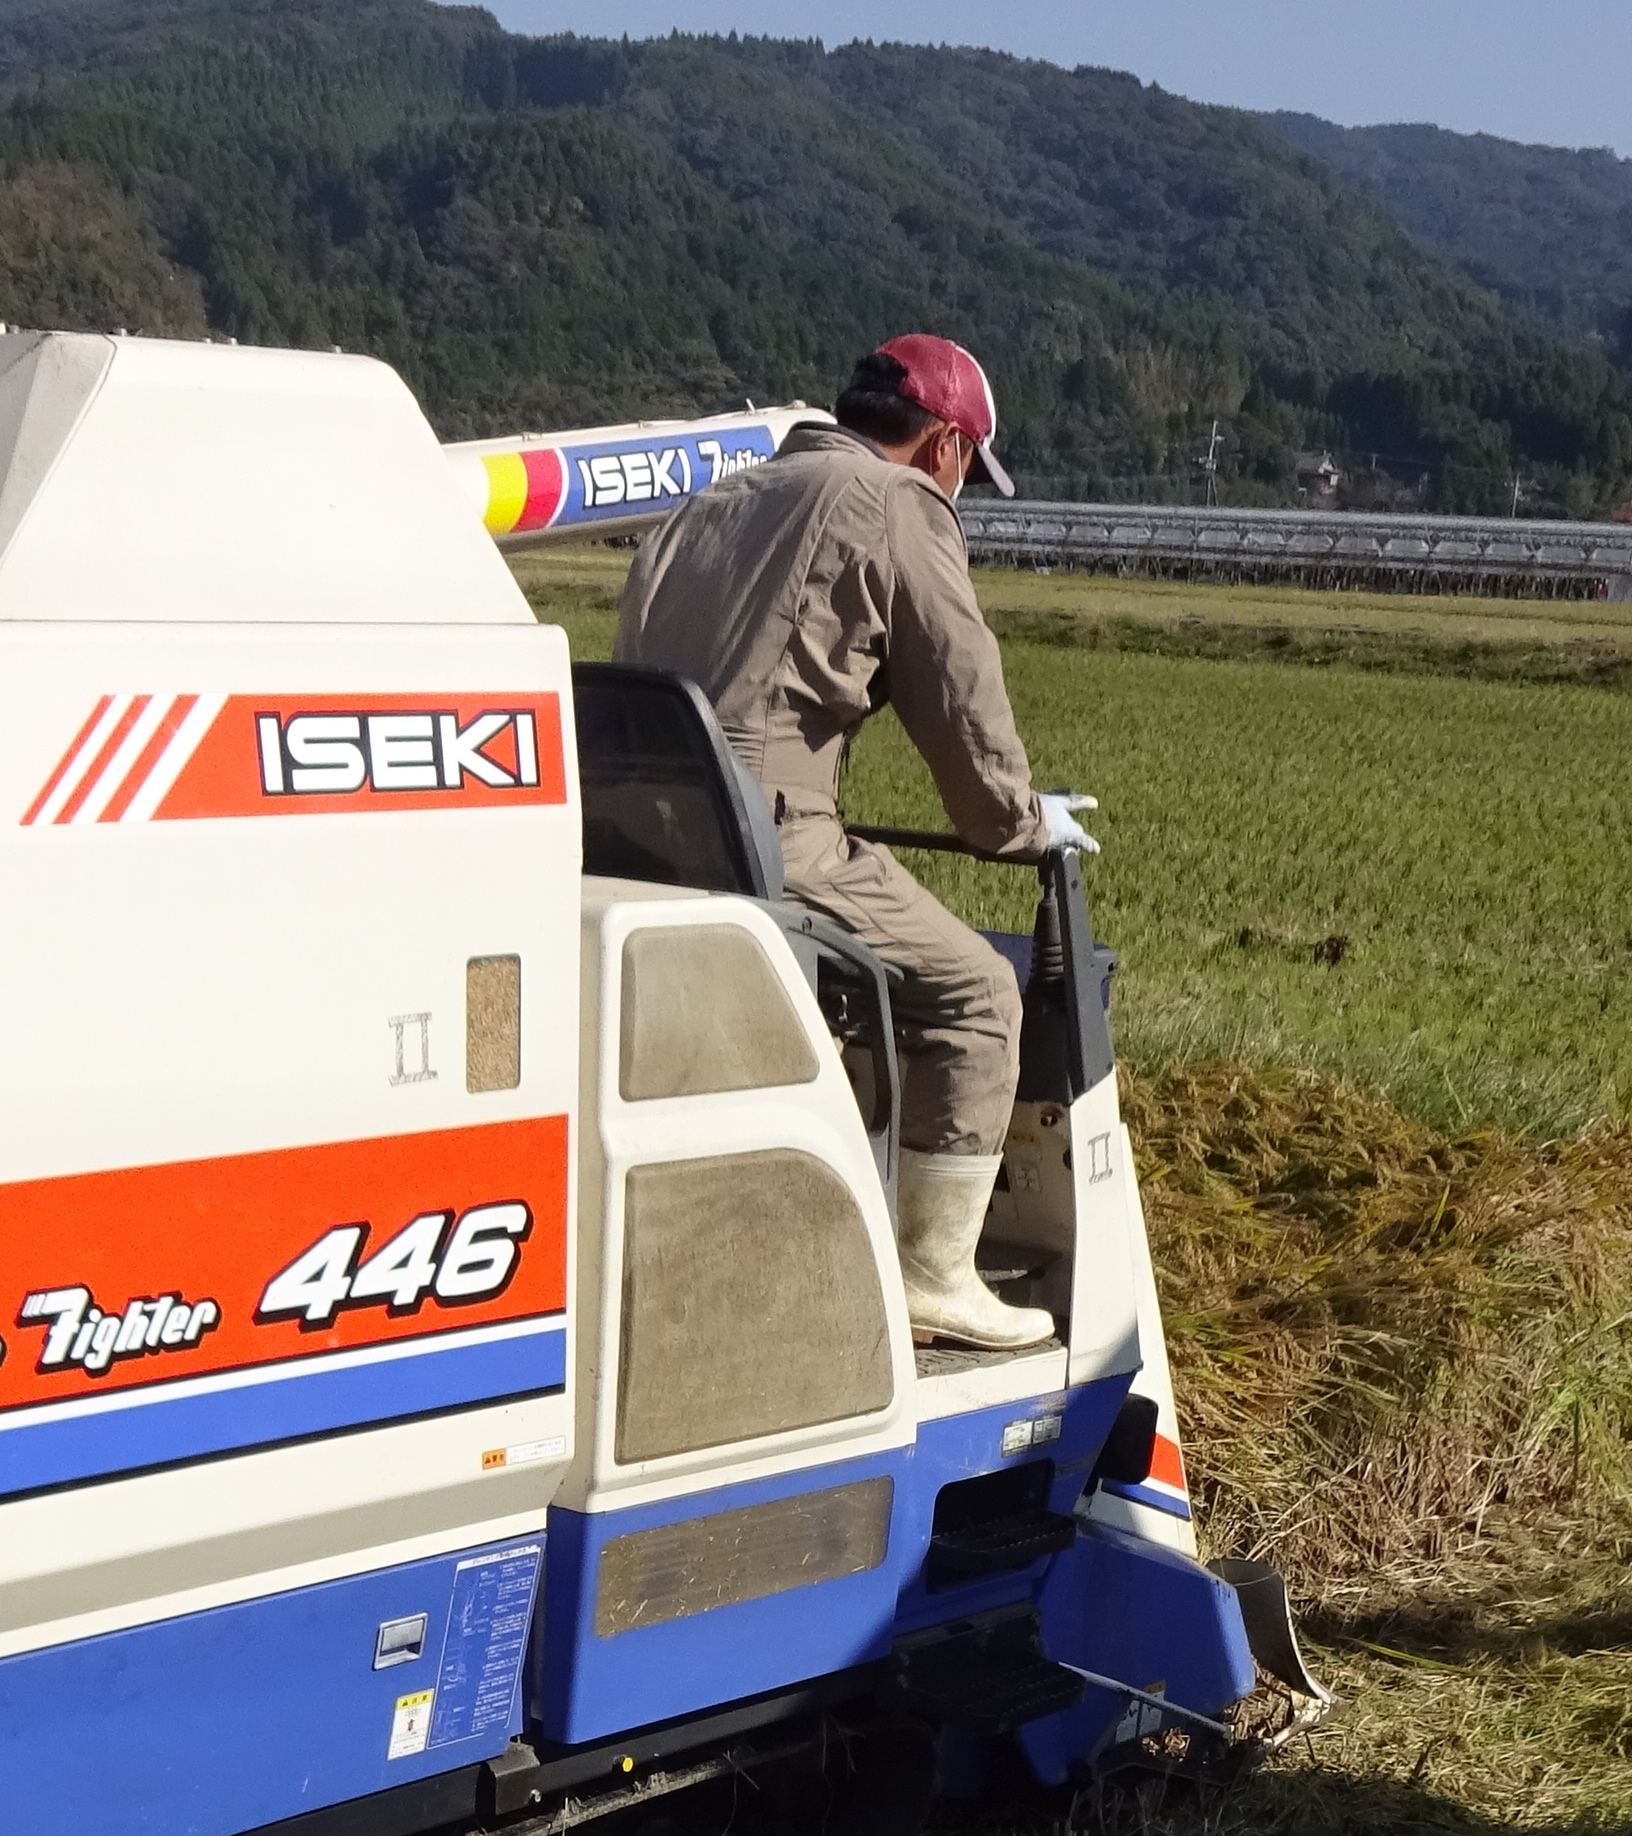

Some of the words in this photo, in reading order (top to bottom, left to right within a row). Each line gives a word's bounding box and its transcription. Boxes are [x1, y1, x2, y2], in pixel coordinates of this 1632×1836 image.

[577, 448, 692, 507] ISEKI
[257, 711, 539, 795] ISEKI
[18, 1285, 219, 1373] Fighter
[256, 1201, 530, 1326] 446
